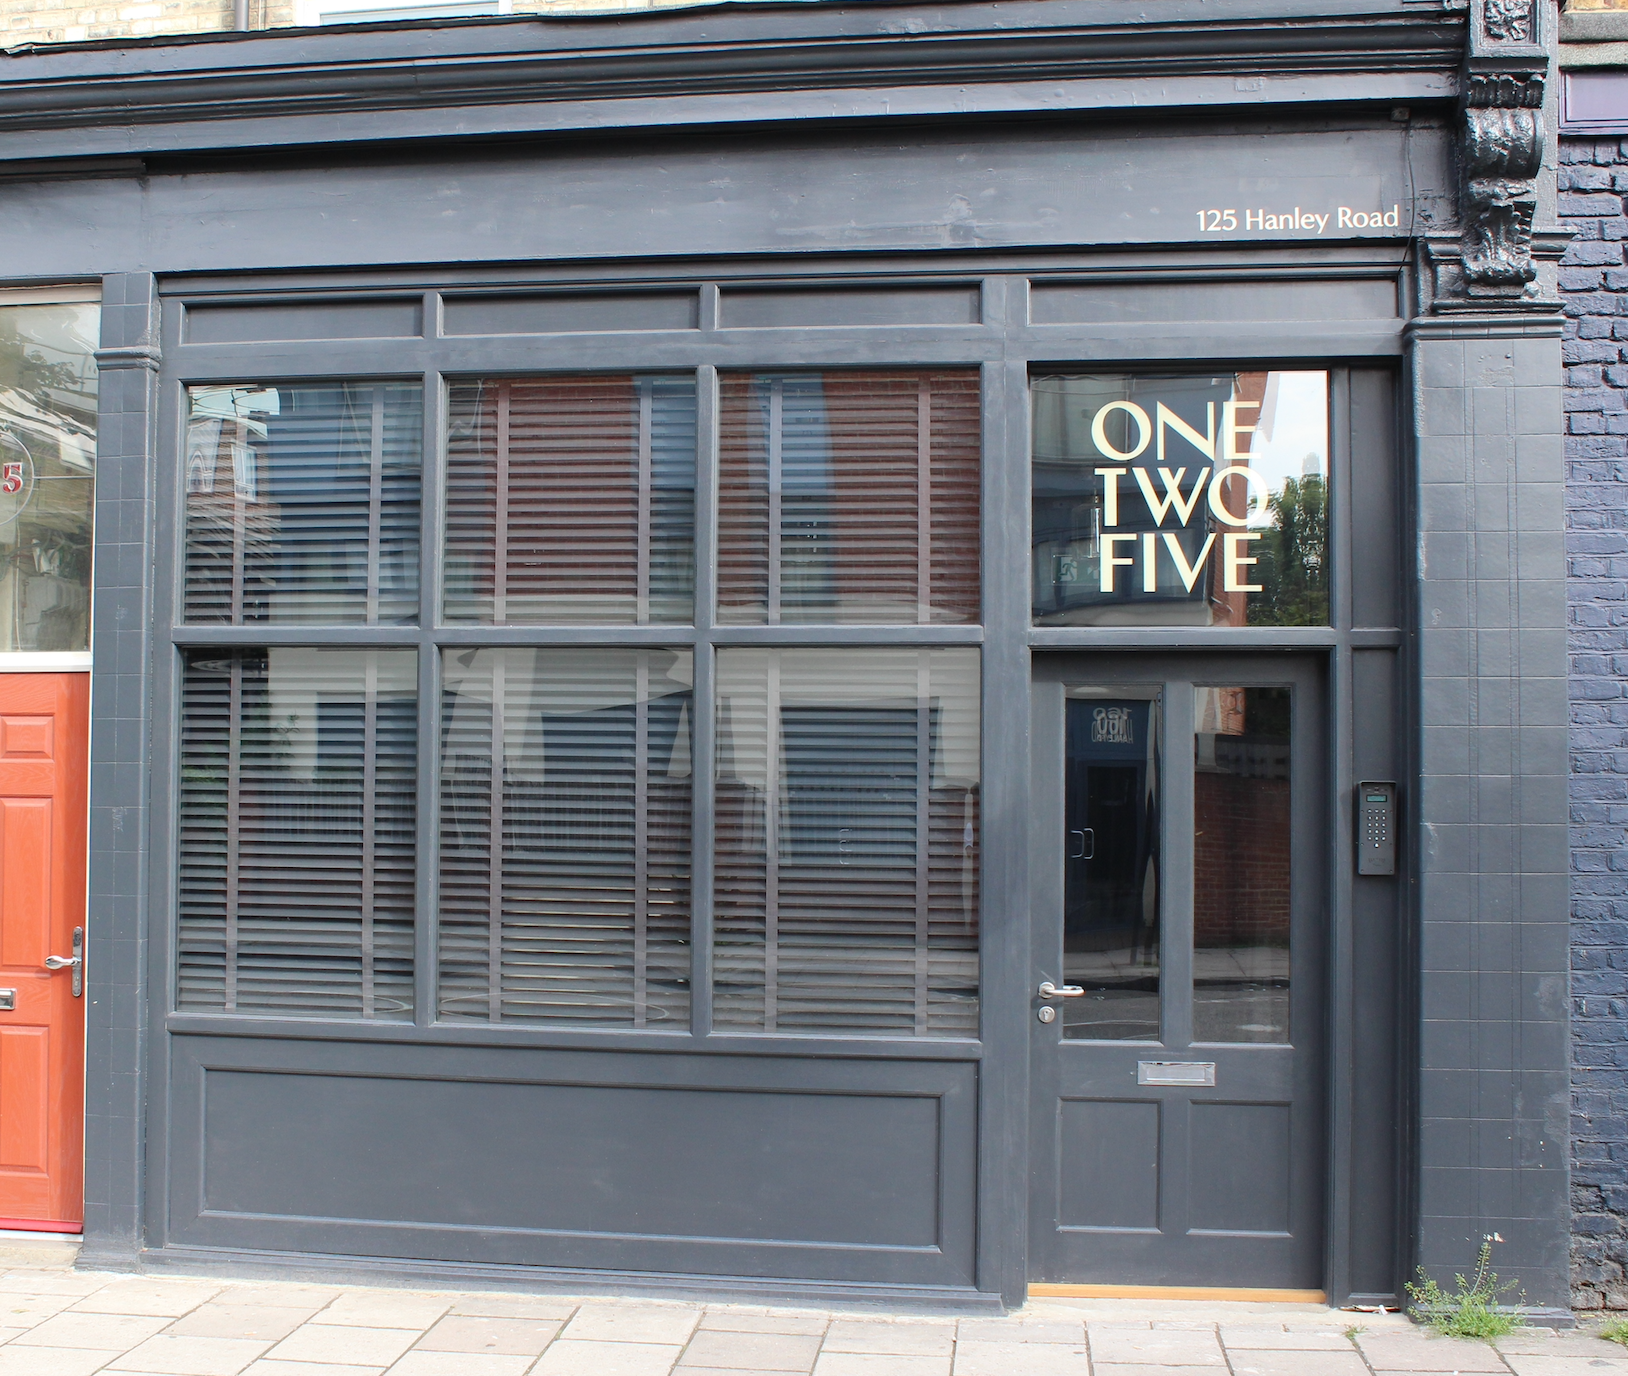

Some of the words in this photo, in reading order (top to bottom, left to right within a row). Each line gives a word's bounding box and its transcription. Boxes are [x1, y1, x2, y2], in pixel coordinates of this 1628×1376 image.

[1196, 209, 1237, 232] 125
[1245, 206, 1330, 235] Hanley
[1337, 204, 1399, 229] Road
[1091, 400, 1262, 462] ONE
[1094, 465, 1269, 528] TWO
[1099, 532, 1264, 594] FIVE
